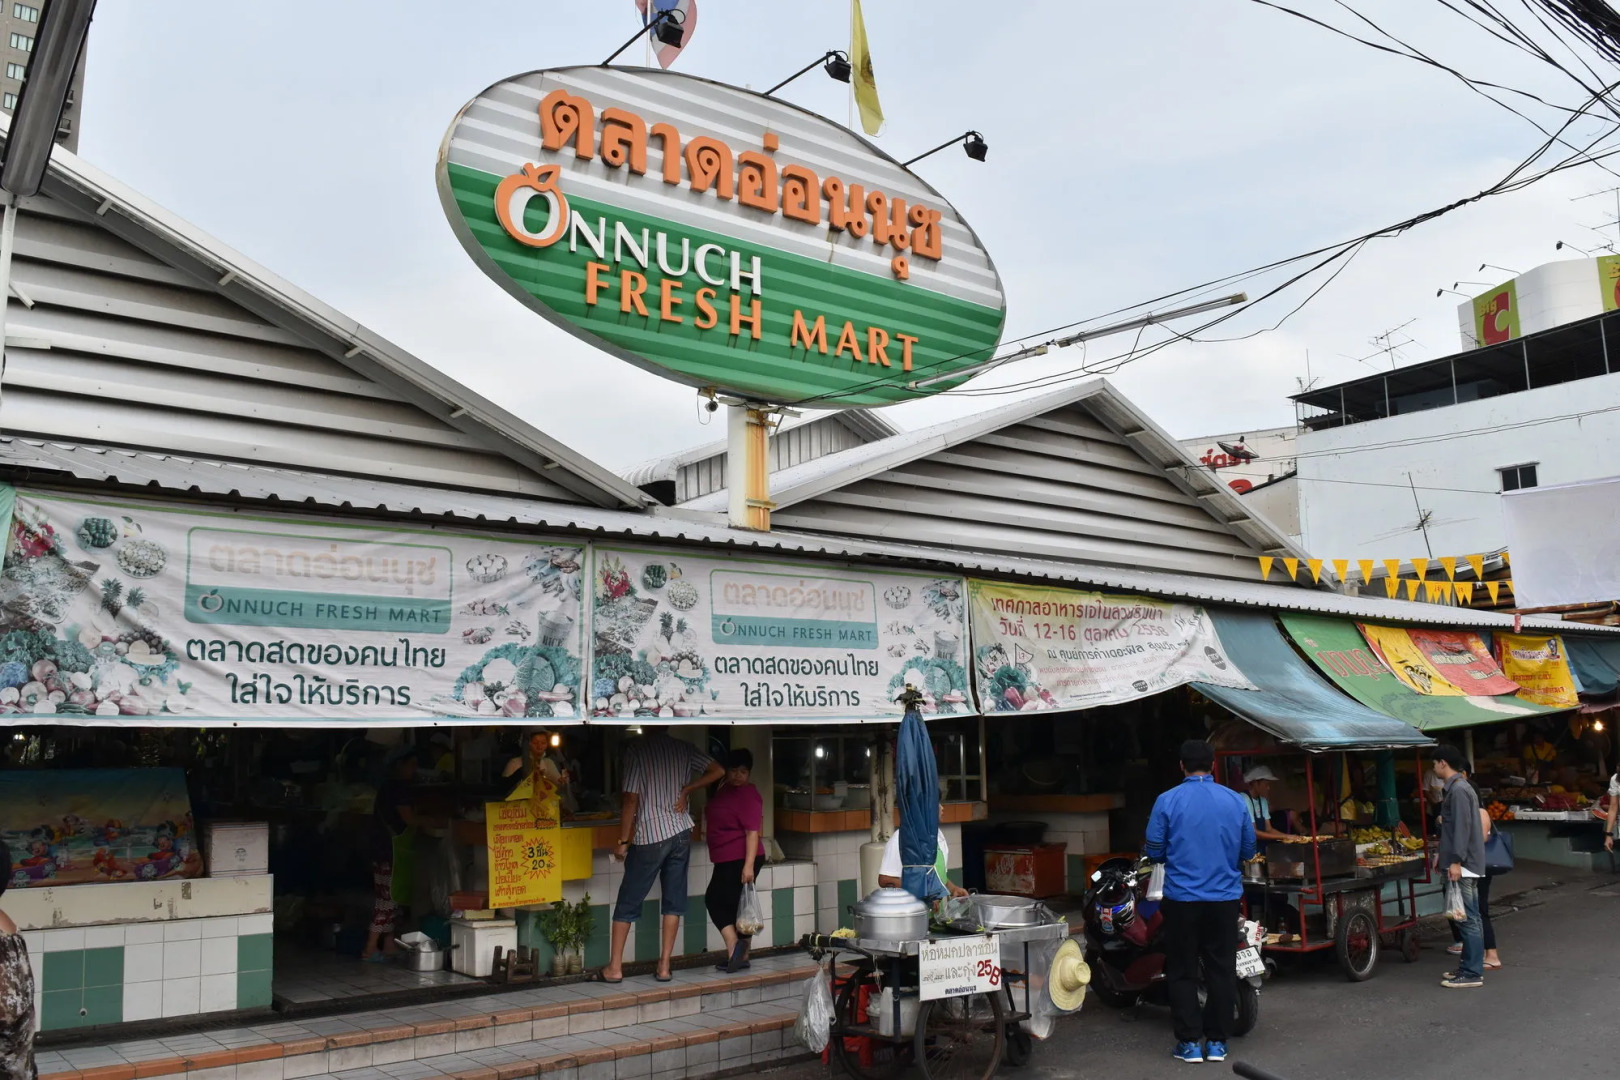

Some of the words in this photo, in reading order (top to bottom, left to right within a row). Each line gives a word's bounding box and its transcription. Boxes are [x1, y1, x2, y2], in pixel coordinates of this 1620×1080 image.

[539, 89, 942, 280] ตลาดอ่อนนุช
[495, 162, 762, 296] ONNUCH
[585, 261, 763, 340] FRESH
[790, 309, 919, 372] MART
[208, 544, 438, 596] ตลาดอ่อนนุช
[198, 590, 303, 617] ONNUCH
[315, 603, 378, 620] FRESH
[388, 607, 442, 623] MART
[724, 580, 865, 618] ตลาดอ่อนนุช
[720, 617, 786, 638] ONNUCH
[792, 627, 832, 641] FRESH
[838, 629, 873, 643] MART
[999, 615, 1027, 638] วันที่
[1033, 622, 1076, 642] 12-16
[1083, 628, 1129, 646] ตุลาคม
[1136, 623, 1170, 638] 2558
[186, 638, 446, 668] ตลาดสดของคนไทย
[713, 653, 879, 677] ตลาดสดของคนไทย
[532, 859, 546, 870] 20
